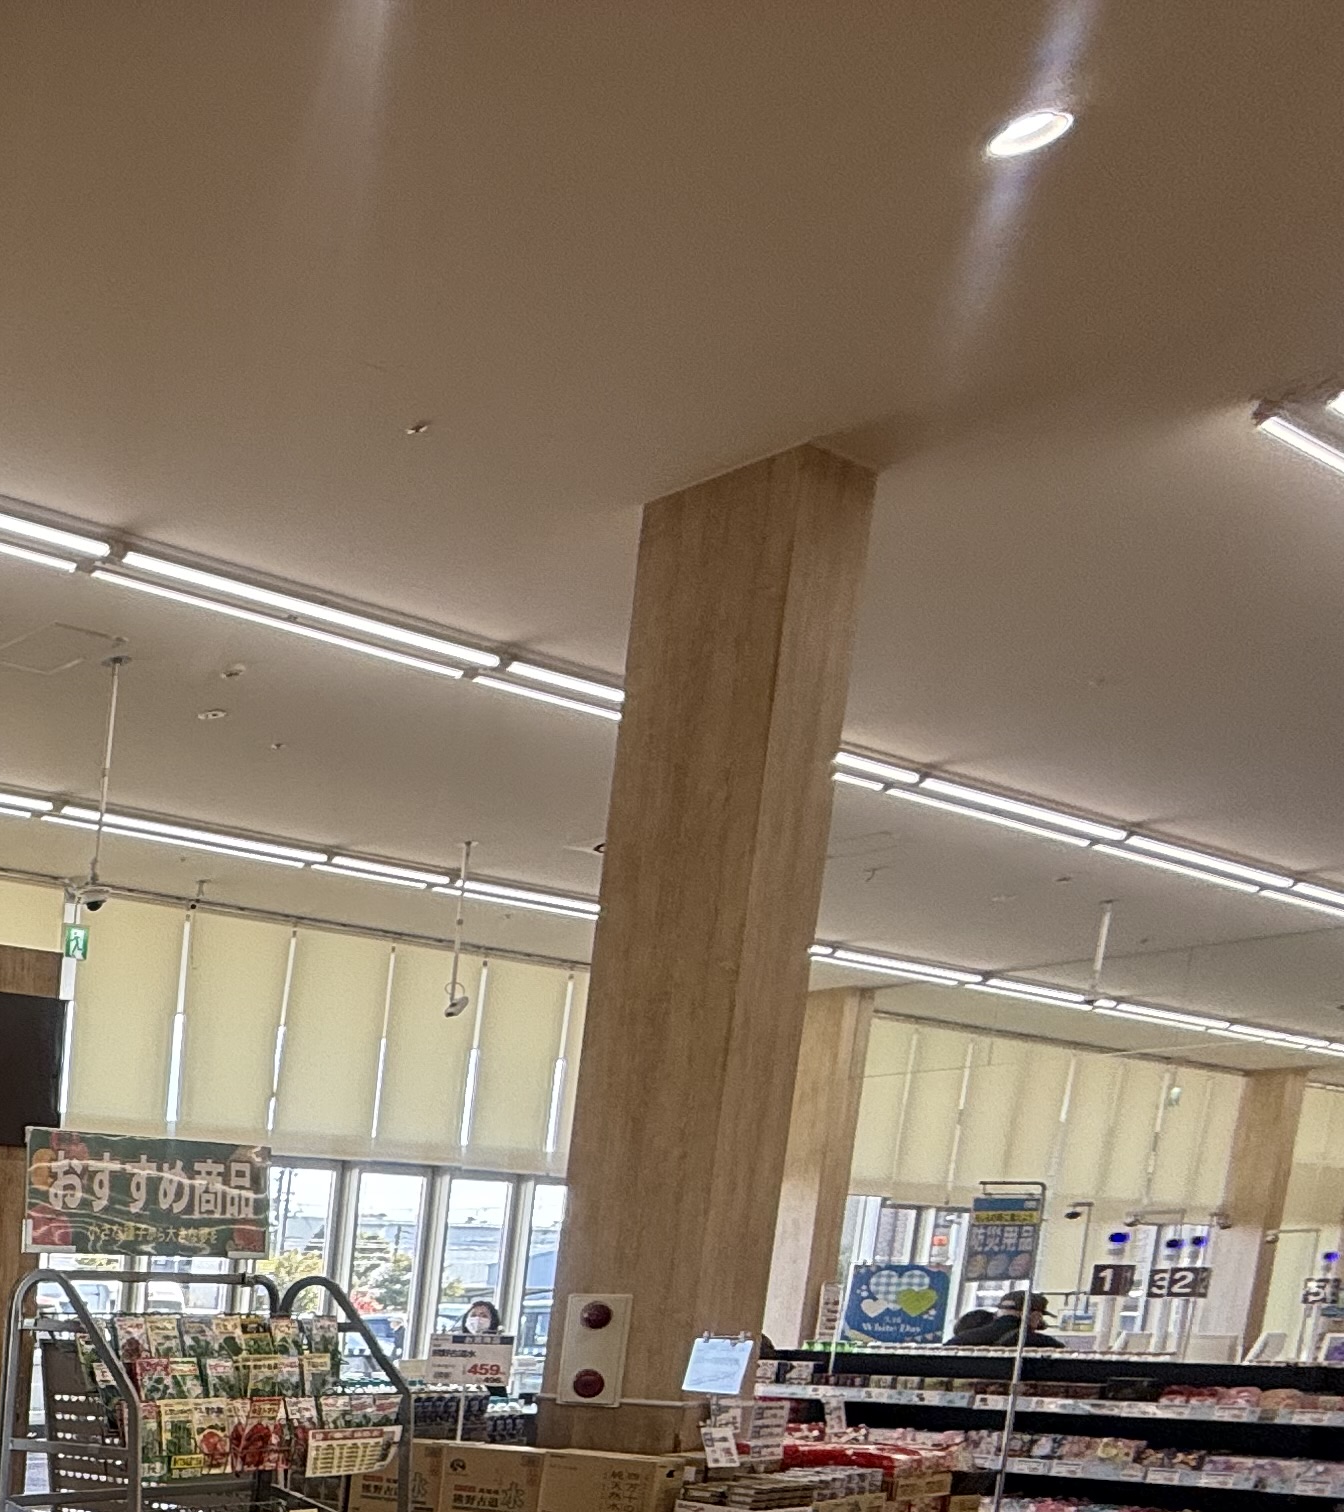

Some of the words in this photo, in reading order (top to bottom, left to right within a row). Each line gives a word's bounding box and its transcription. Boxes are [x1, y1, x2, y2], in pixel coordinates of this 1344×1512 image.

[48, 1150, 255, 1218] おすすめ商品
[1098, 1268, 1113, 1292] 1
[1170, 1271, 1196, 1294] 2
[467, 1363, 501, 1377] 459
